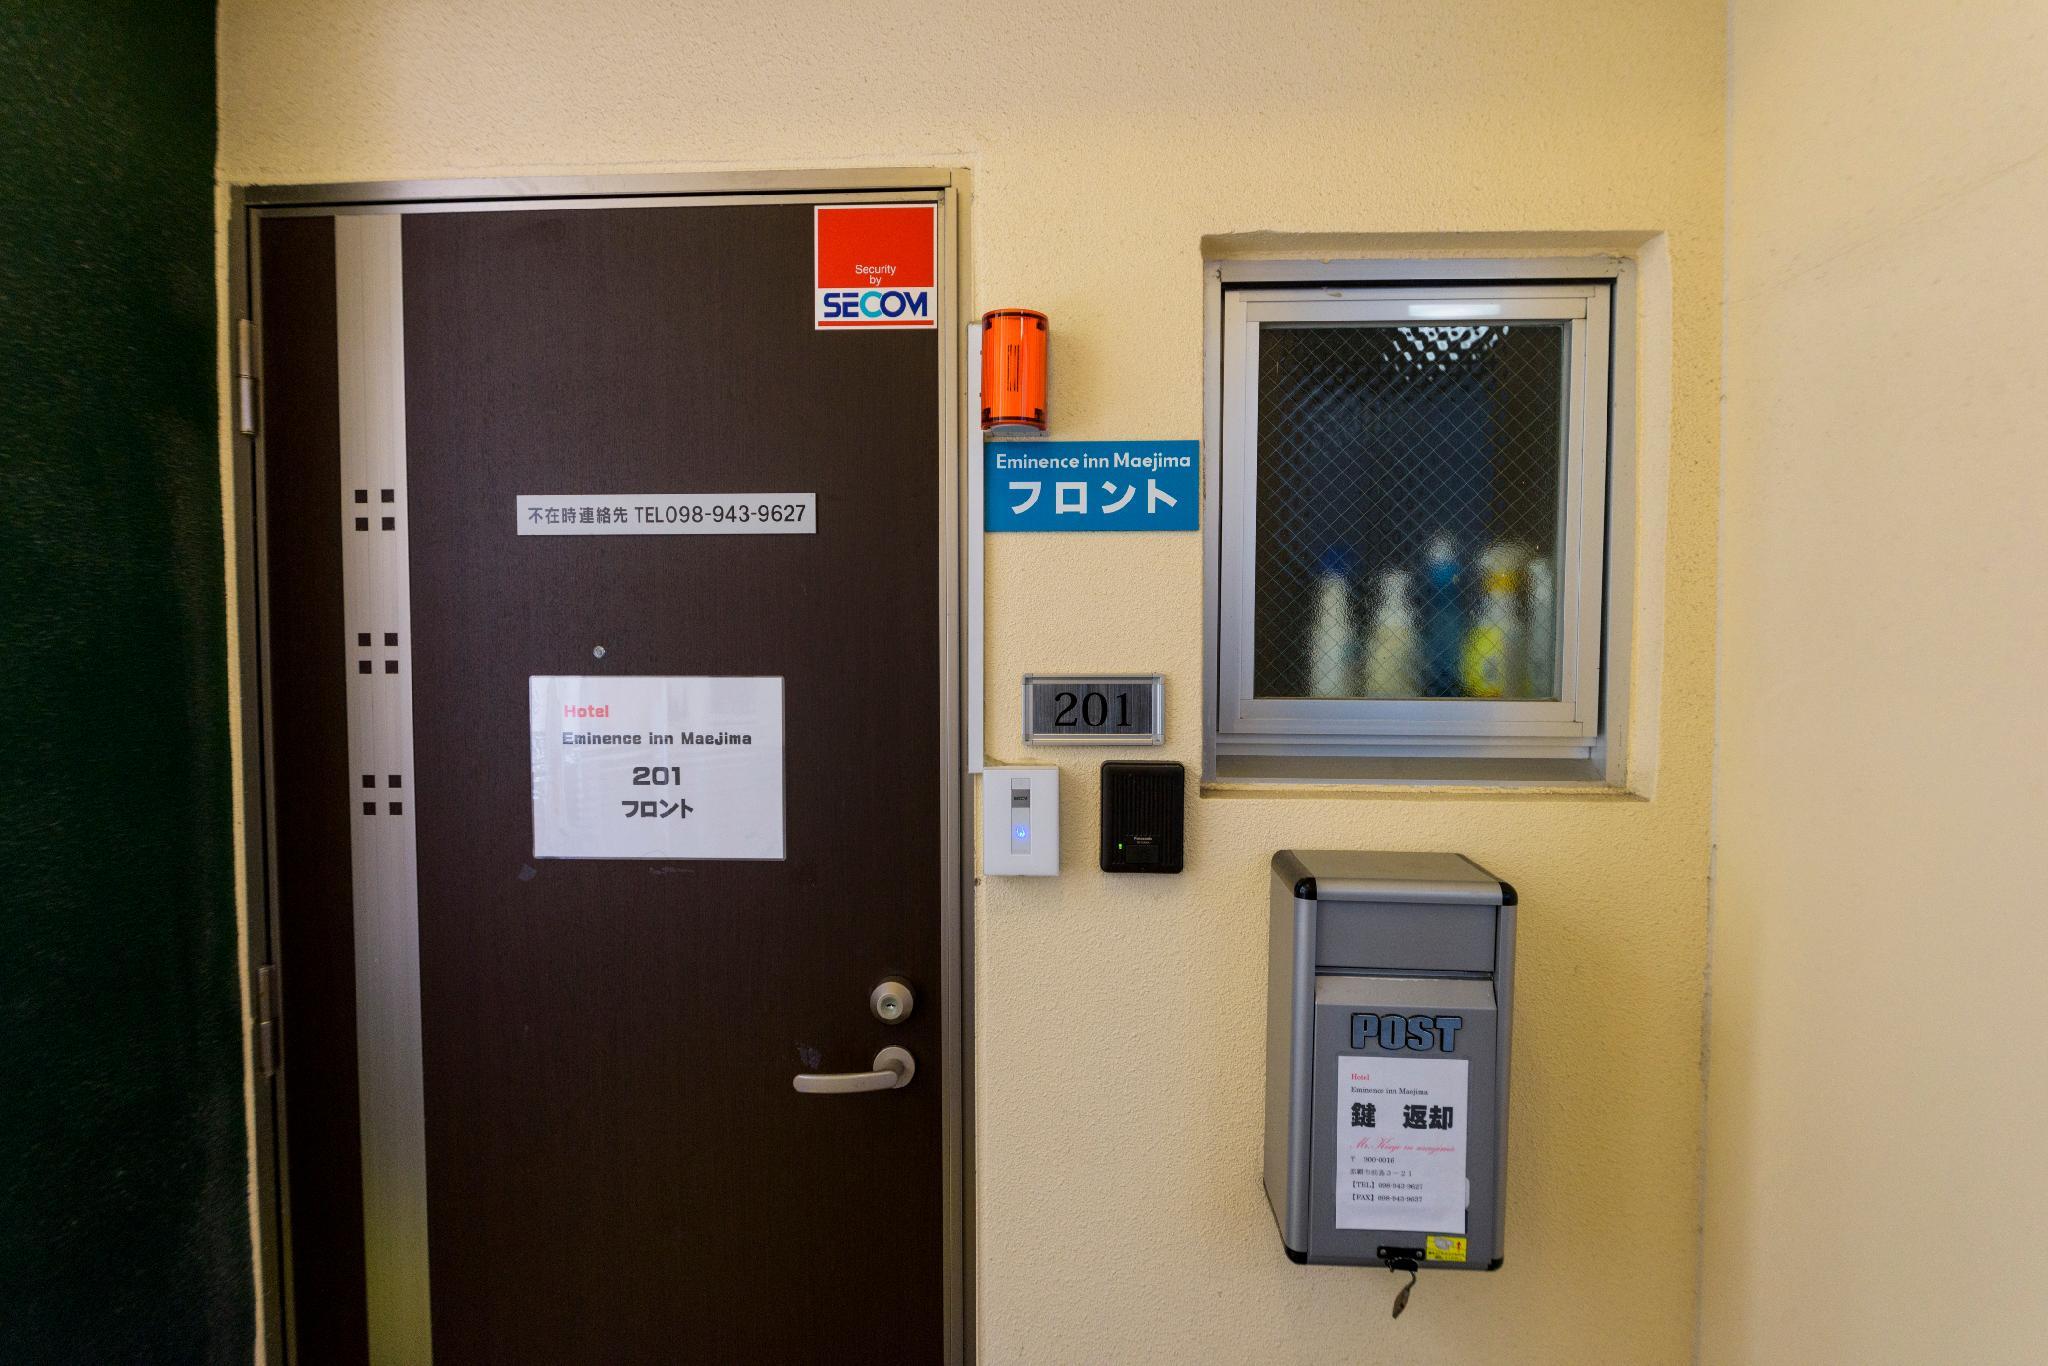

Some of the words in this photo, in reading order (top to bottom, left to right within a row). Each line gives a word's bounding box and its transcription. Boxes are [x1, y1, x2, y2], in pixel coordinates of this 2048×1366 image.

[855, 264, 897, 276] Security
[869, 275, 882, 286] by
[823, 290, 928, 318] SECOM
[996, 453, 1080, 469] Eminence
[1083, 454, 1109, 469] inn
[1113, 452, 1191, 472] Maejima
[1008, 478, 1178, 515] フロント
[527, 506, 628, 525] 不在時連絡先
[634, 504, 807, 524] TEL098-943-9627
[564, 704, 609, 718] Hotel
[1054, 692, 1132, 727] 201
[562, 732, 642, 746] Eminence
[649, 731, 674, 745] inn
[681, 731, 752, 746] Maejima
[632, 766, 681, 786] 201
[621, 798, 694, 819] フロント
[1351, 1013, 1463, 1052] POST
[1351, 1073, 1370, 1081] Hotel
[1351, 1086, 1384, 1094] Eminence
[1399, 1088, 1429, 1096] Maejima
[1351, 1102, 1376, 1128] 鍵
[1402, 1104, 1454, 1130] 返却
